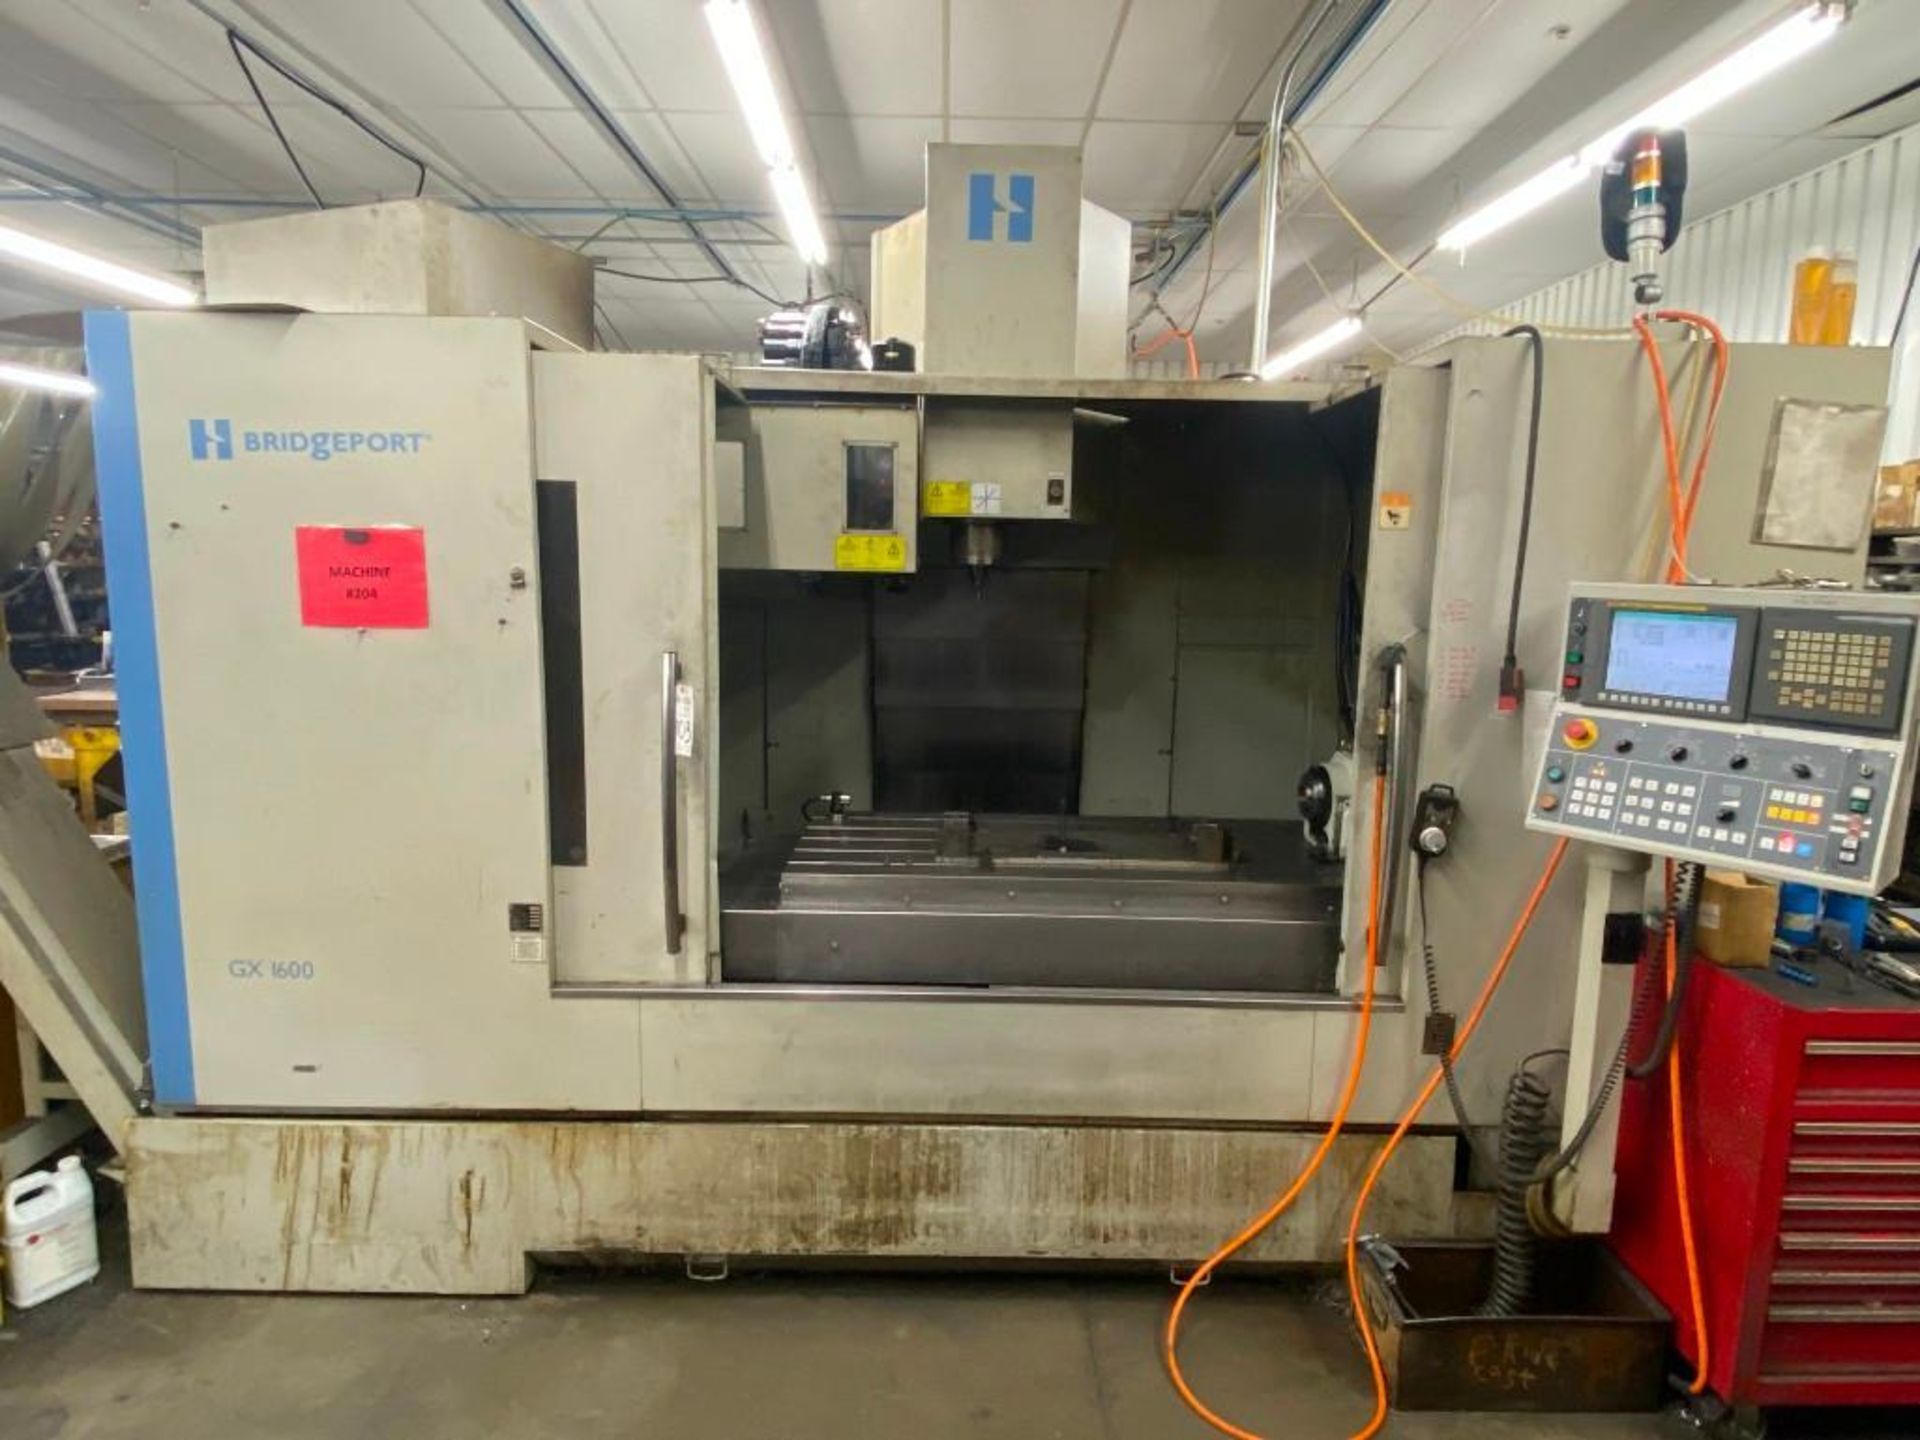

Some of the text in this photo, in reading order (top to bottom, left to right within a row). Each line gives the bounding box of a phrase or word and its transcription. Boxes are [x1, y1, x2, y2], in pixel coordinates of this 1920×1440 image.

[328, 566, 391, 579] MACHINE
[228, 959, 314, 980] GX 1600
